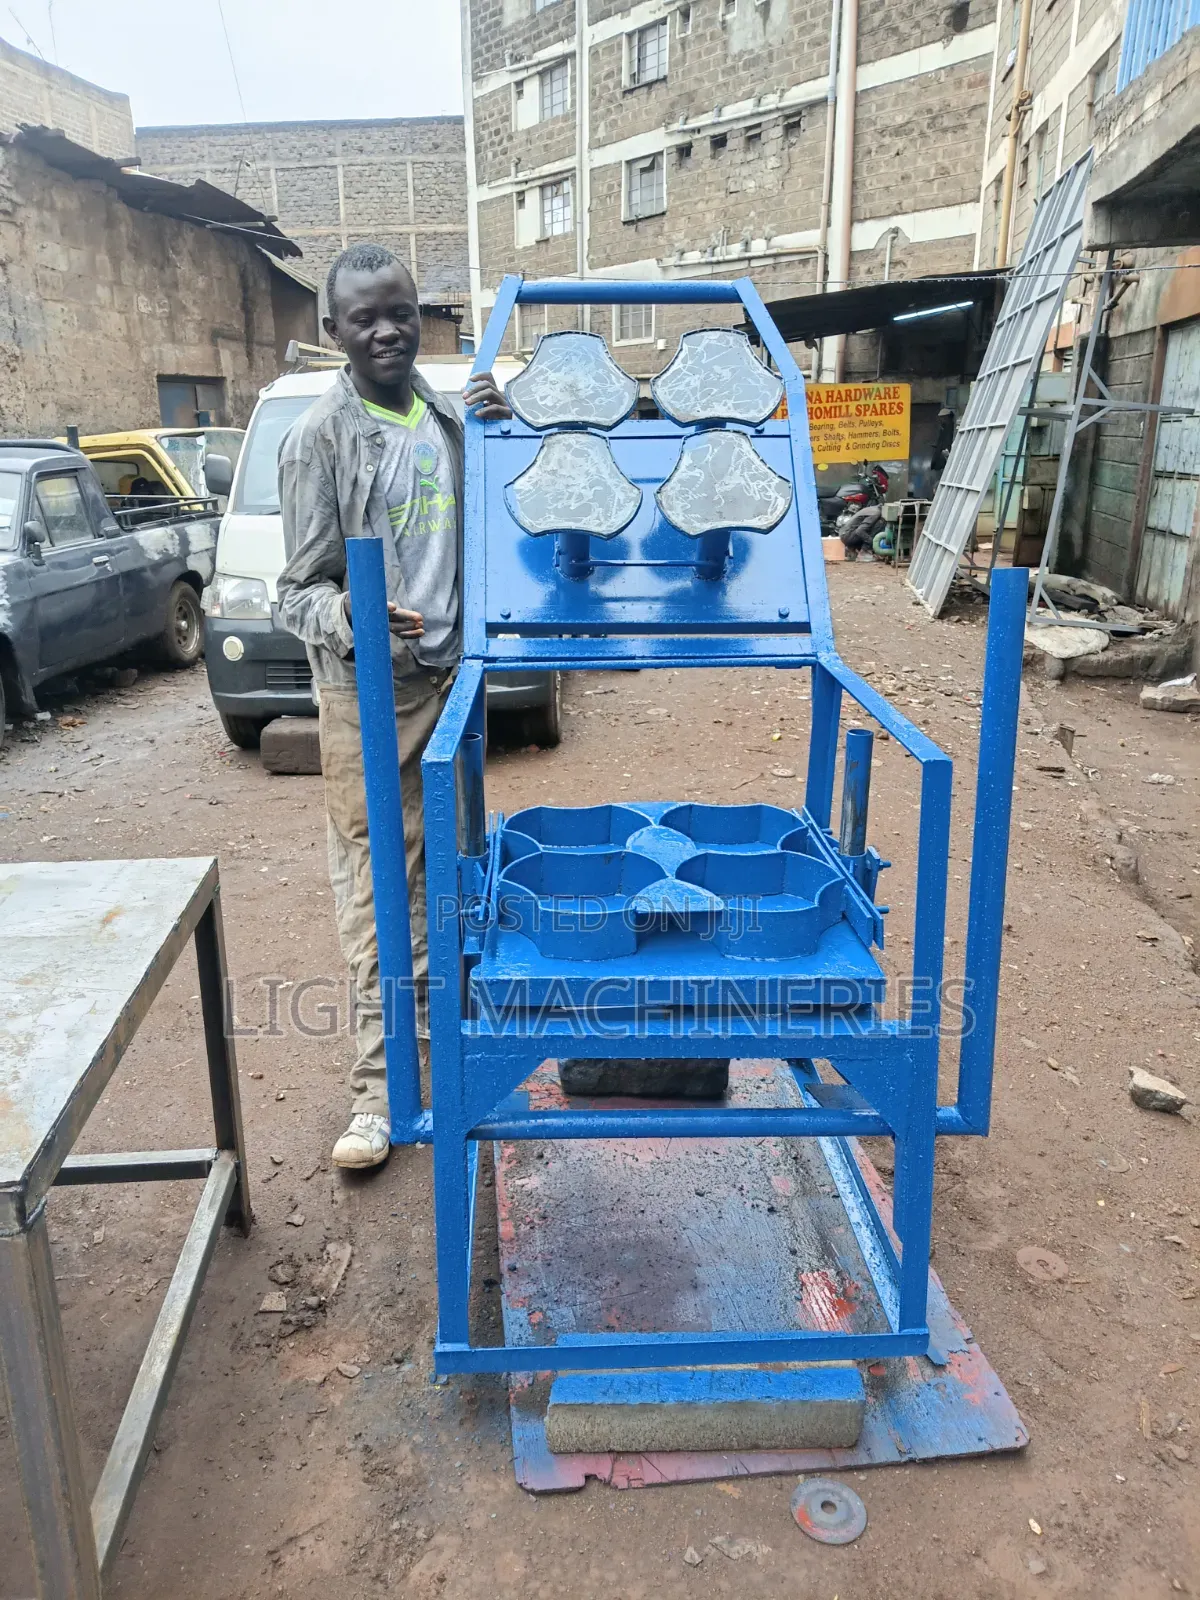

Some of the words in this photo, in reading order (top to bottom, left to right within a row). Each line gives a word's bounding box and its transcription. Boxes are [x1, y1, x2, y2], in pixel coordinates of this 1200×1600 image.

[825, 386, 900, 404] HARDWARE
[855, 402, 904, 418] SPARES
[852, 441, 880, 451] Grinding
[881, 440, 900, 448] Discs
[402, 517, 456, 538] AIRWA
